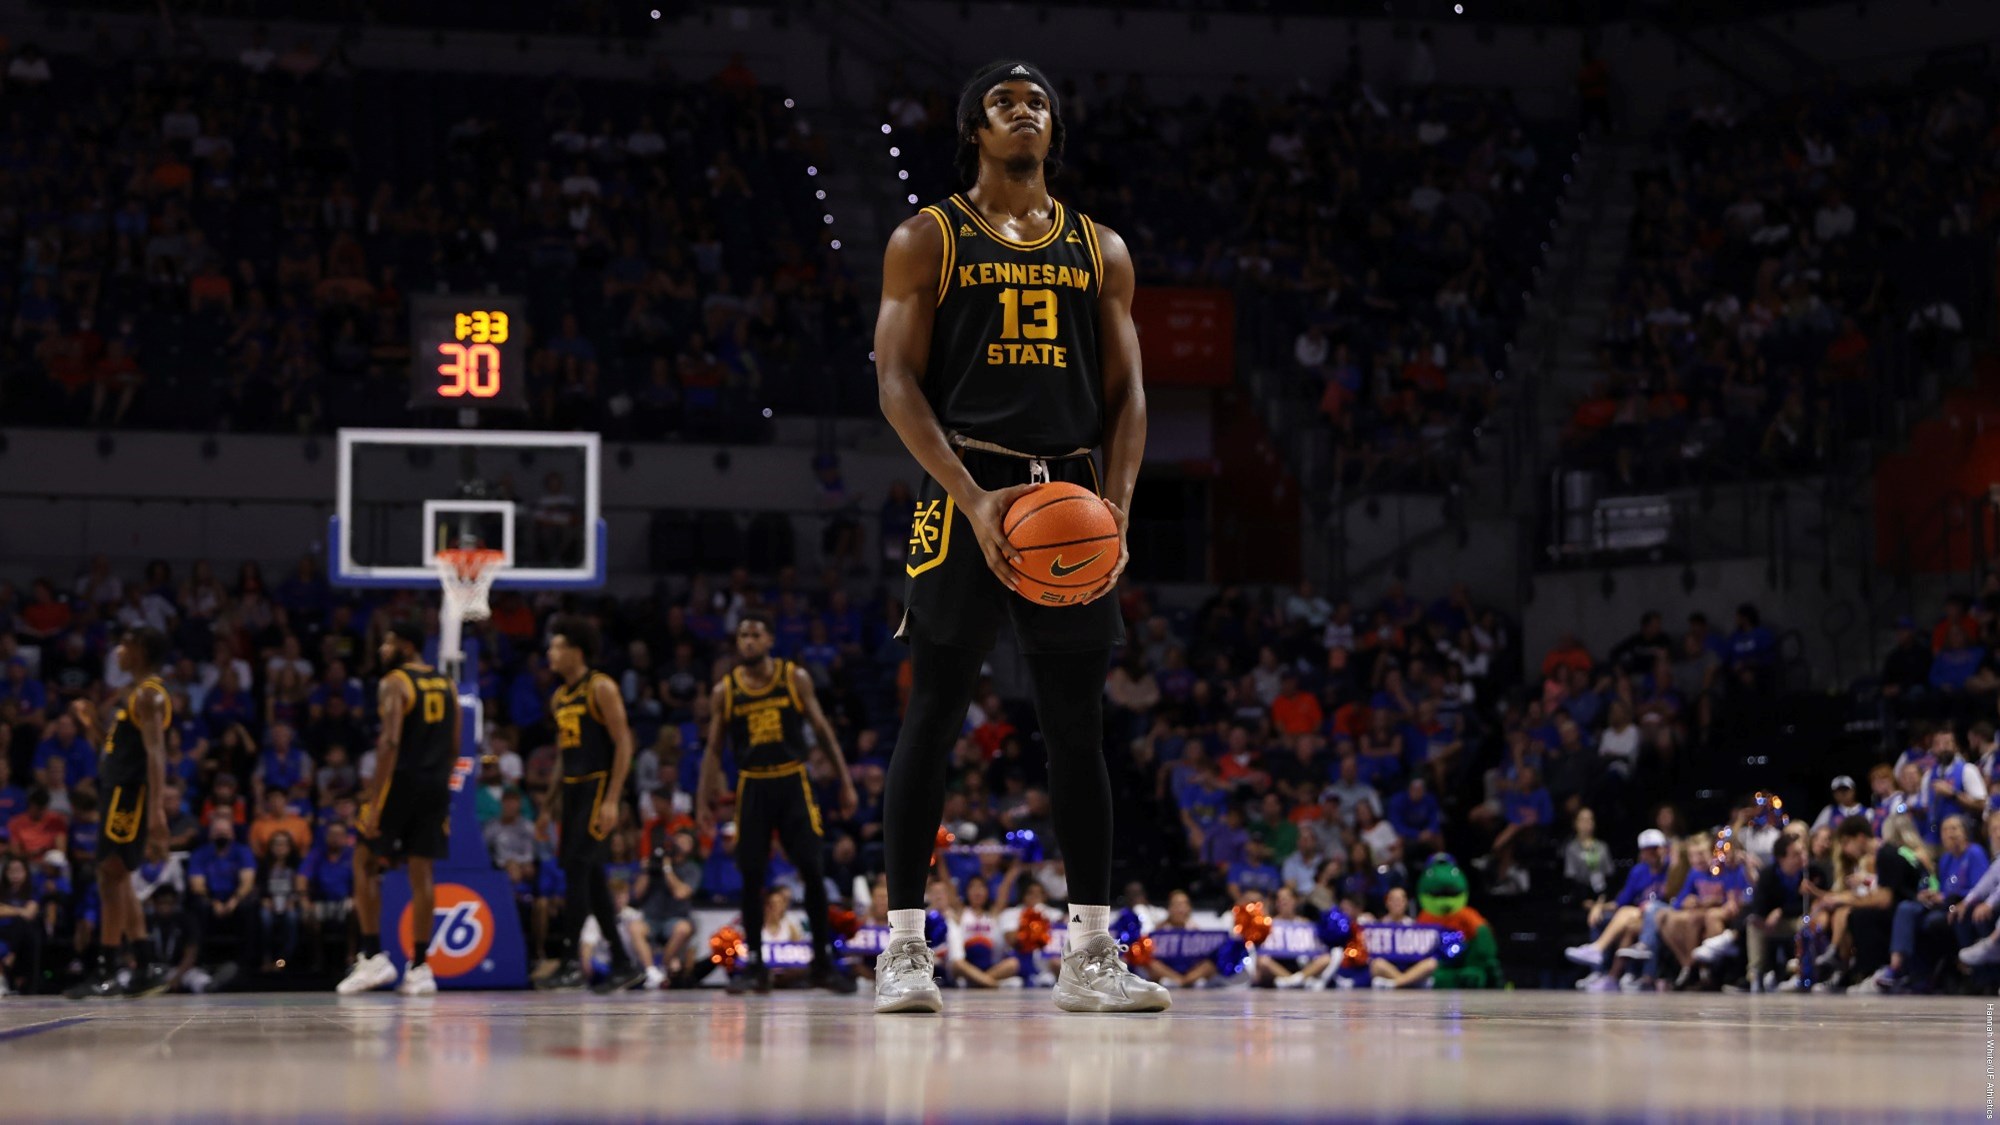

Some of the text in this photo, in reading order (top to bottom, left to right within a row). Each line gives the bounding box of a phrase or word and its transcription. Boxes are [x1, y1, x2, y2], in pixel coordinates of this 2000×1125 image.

[958, 262, 1090, 292] KENNESAW
[998, 287, 1058, 340] 13
[437, 343, 500, 397] 30
[987, 343, 1067, 368] STATE
[1040, 591, 1090, 603] ELIT
[426, 901, 483, 958] 76
